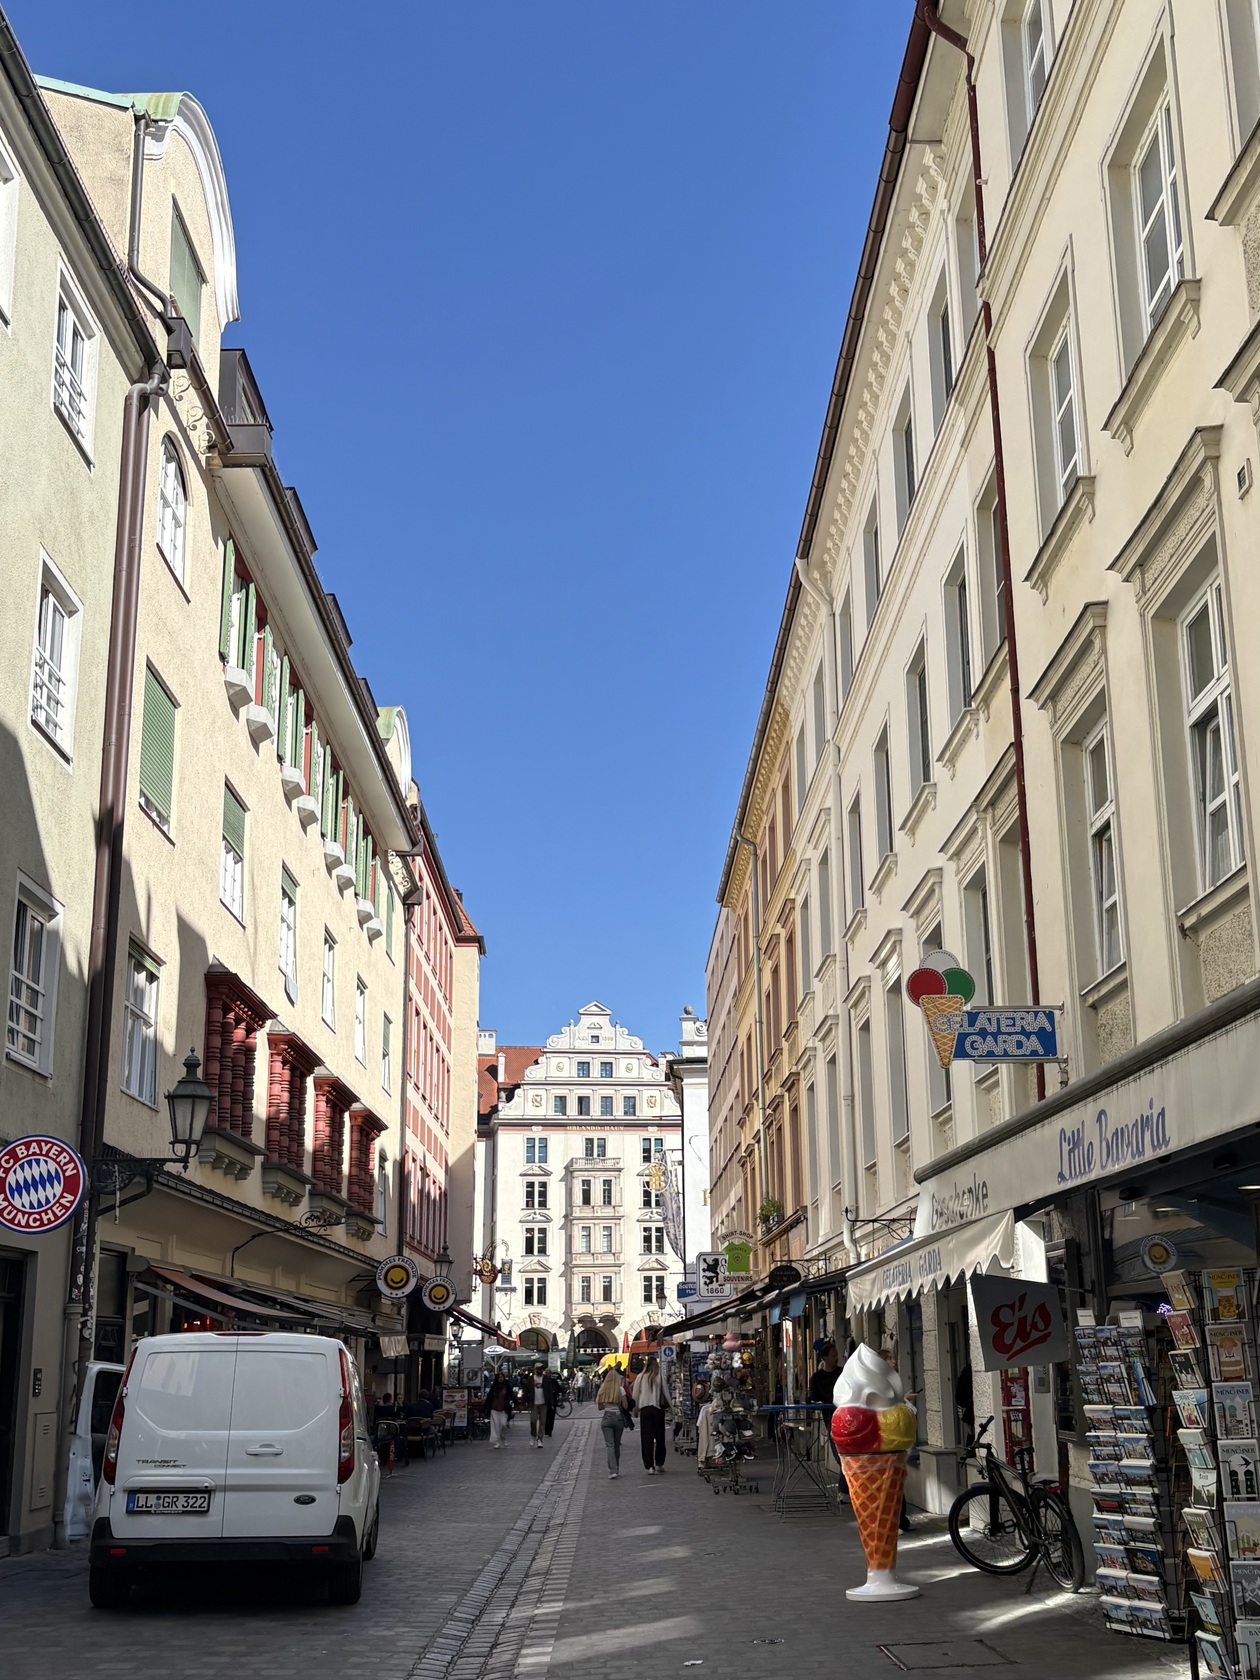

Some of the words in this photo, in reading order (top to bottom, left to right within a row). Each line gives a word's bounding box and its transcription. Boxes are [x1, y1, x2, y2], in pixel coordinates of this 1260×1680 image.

[932, 1012, 1052, 1034] GELATERIA
[965, 1034, 1045, 1056] GARDA
[1057, 1119, 1096, 1185] Little
[1096, 1097, 1171, 1171] Bavaria
[15, 1142, 77, 1177] BAYERN
[722, 1231, 754, 1241] SHIRT-SHOP
[377, 1257, 397, 1281] POMMES
[397, 1257, 418, 1280] FREUNDE
[883, 1260, 912, 1289] GELATERIA
[919, 1246, 942, 1279] GARDA
[723, 1275, 753, 1283] SOUVENIRS
[705, 1287, 725, 1295] 1860
[990, 1292, 1052, 1355] Eis
[136, 1496, 153, 1509] LL
[162, 1496, 179, 1509] GR
[182, 1496, 207, 1509] 322
